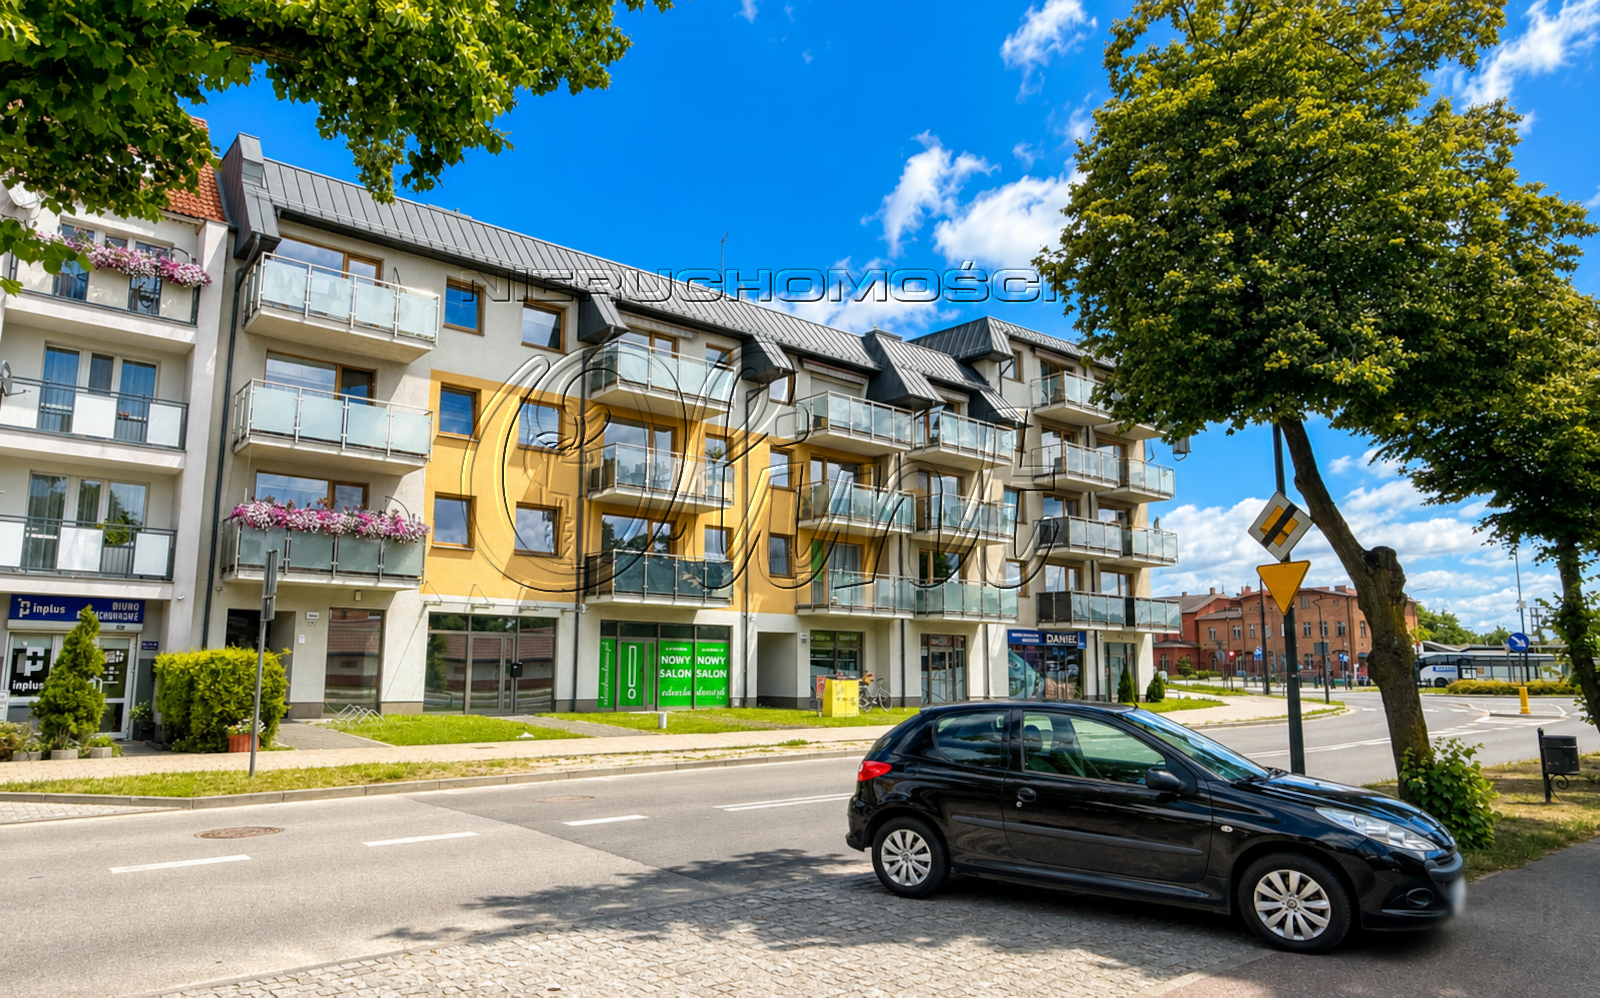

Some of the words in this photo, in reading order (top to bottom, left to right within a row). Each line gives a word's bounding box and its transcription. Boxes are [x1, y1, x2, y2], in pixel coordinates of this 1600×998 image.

[33, 603, 66, 615] inplus
[661, 655, 691, 665] NOWY
[697, 656, 726, 665] NOWY
[659, 669, 692, 678] SALON
[696, 669, 727, 678] SALON
[12, 680, 45, 691] inplus
